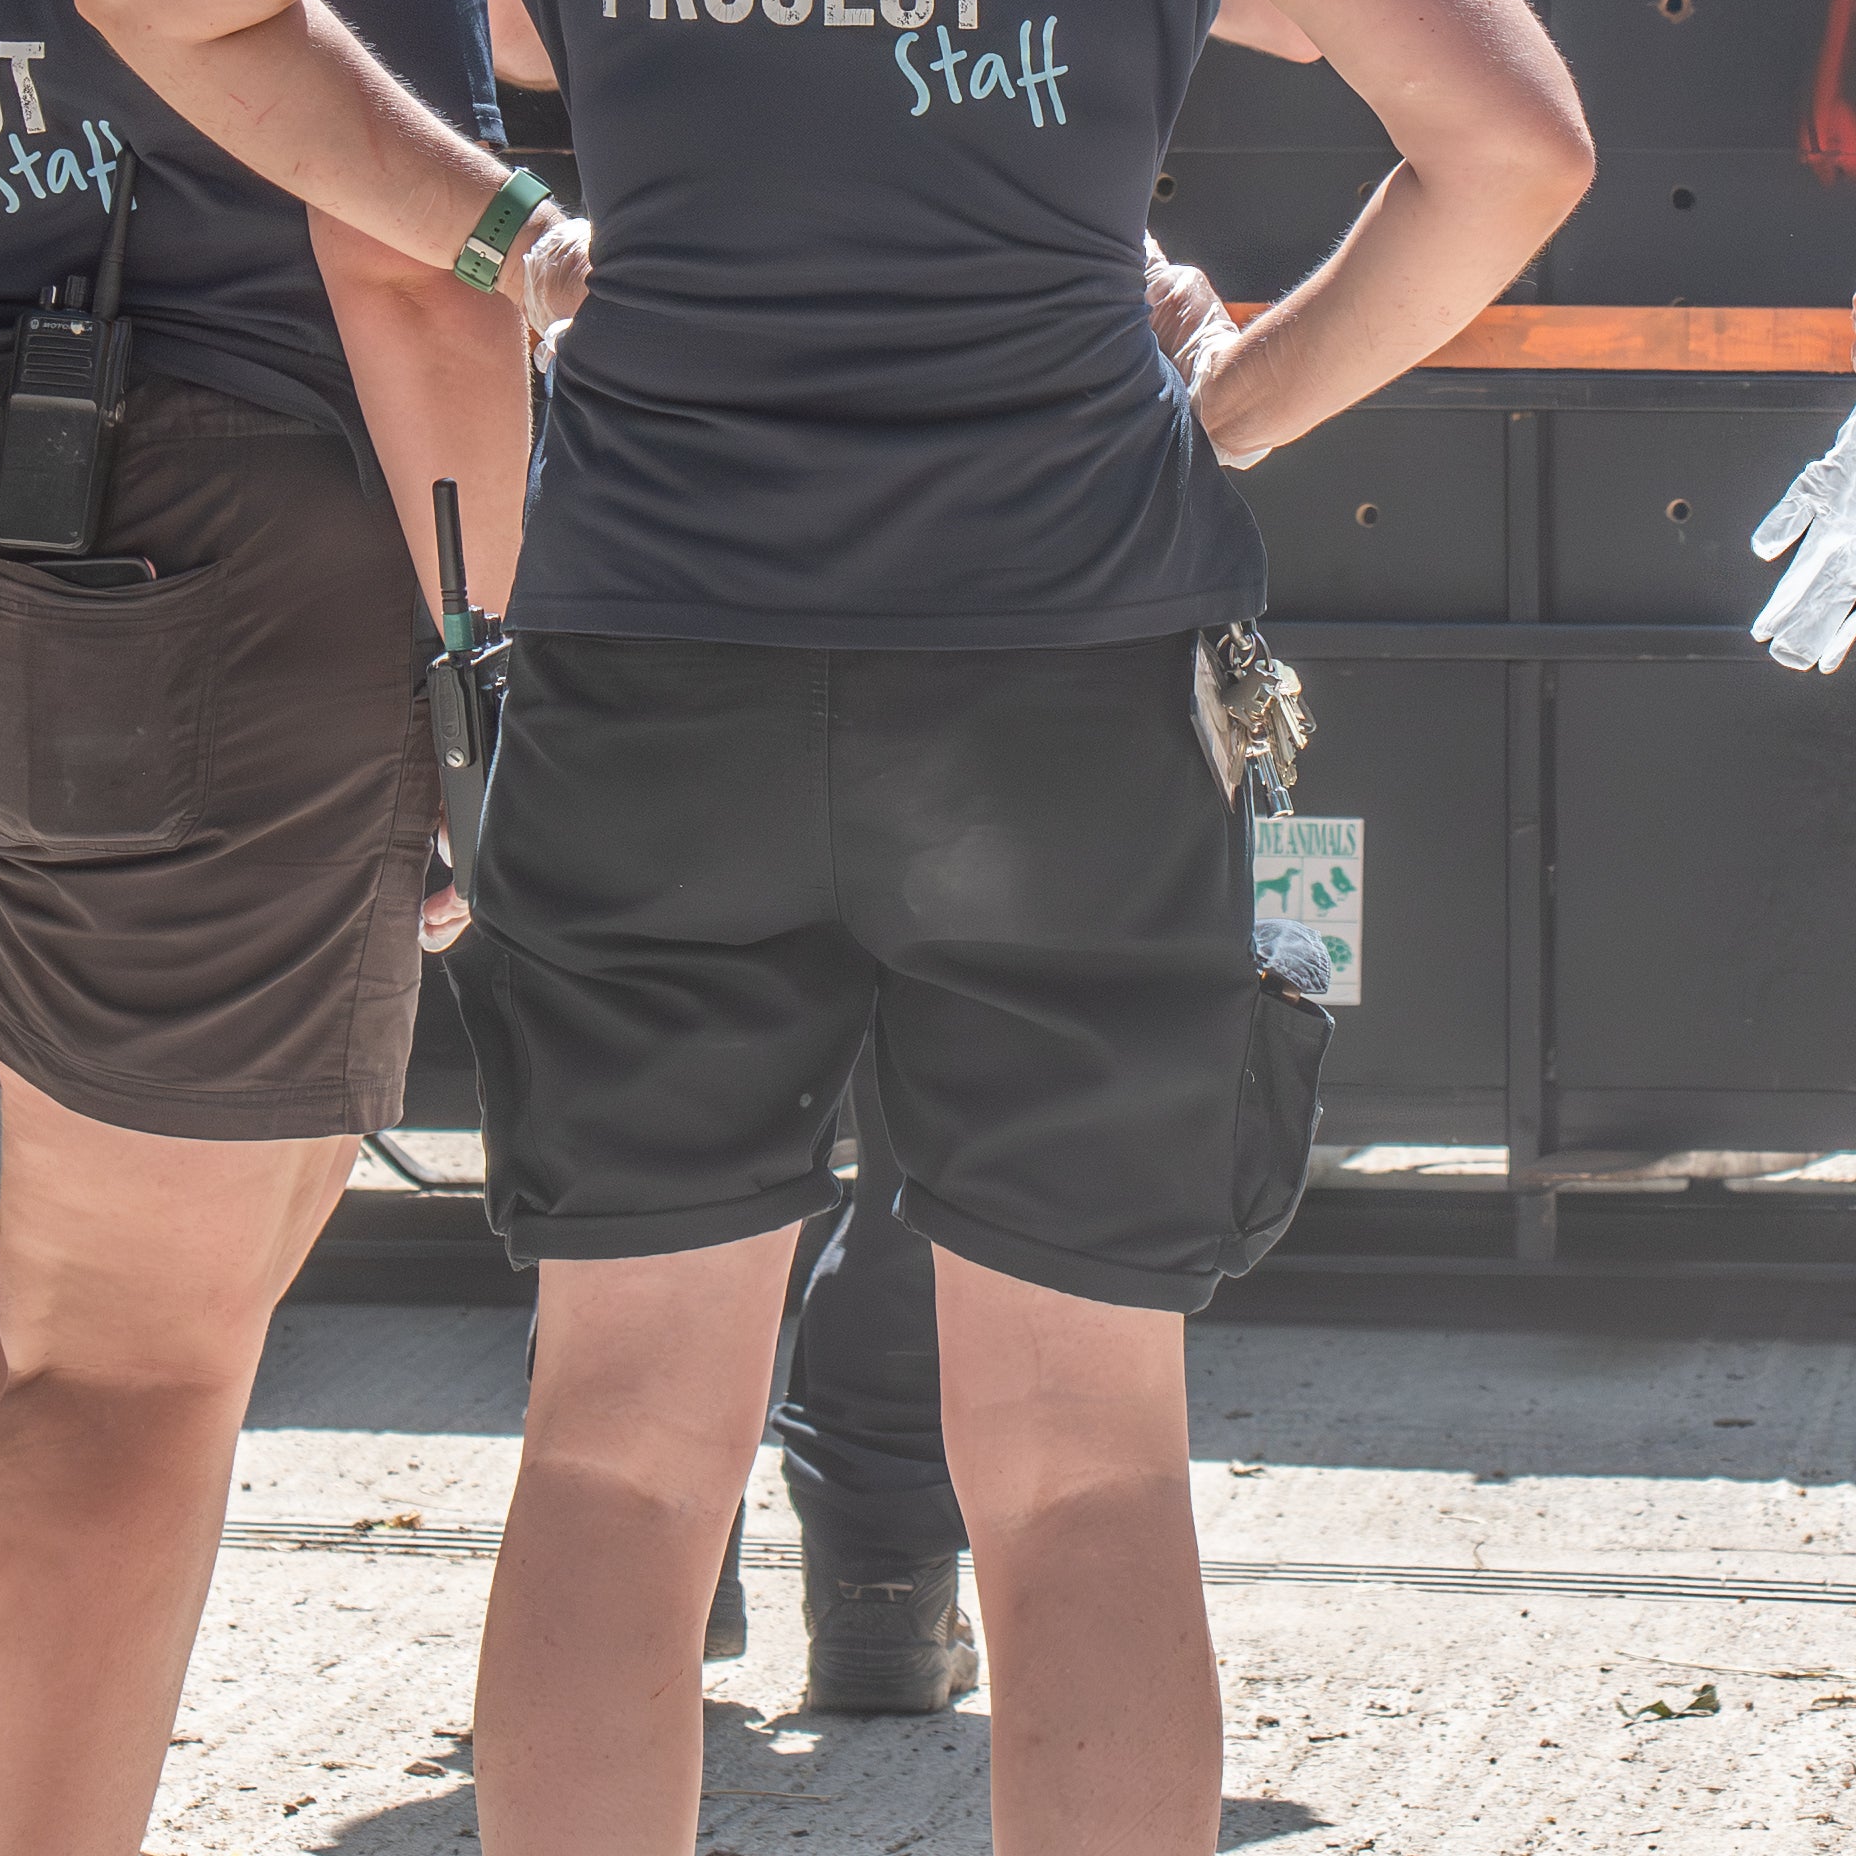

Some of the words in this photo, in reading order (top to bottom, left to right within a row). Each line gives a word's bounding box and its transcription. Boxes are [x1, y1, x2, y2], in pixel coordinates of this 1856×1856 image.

[895, 16, 1068, 128] Staff
[1255, 822, 1283, 855] IVE
[1287, 823, 1357, 856] ANIMALS
